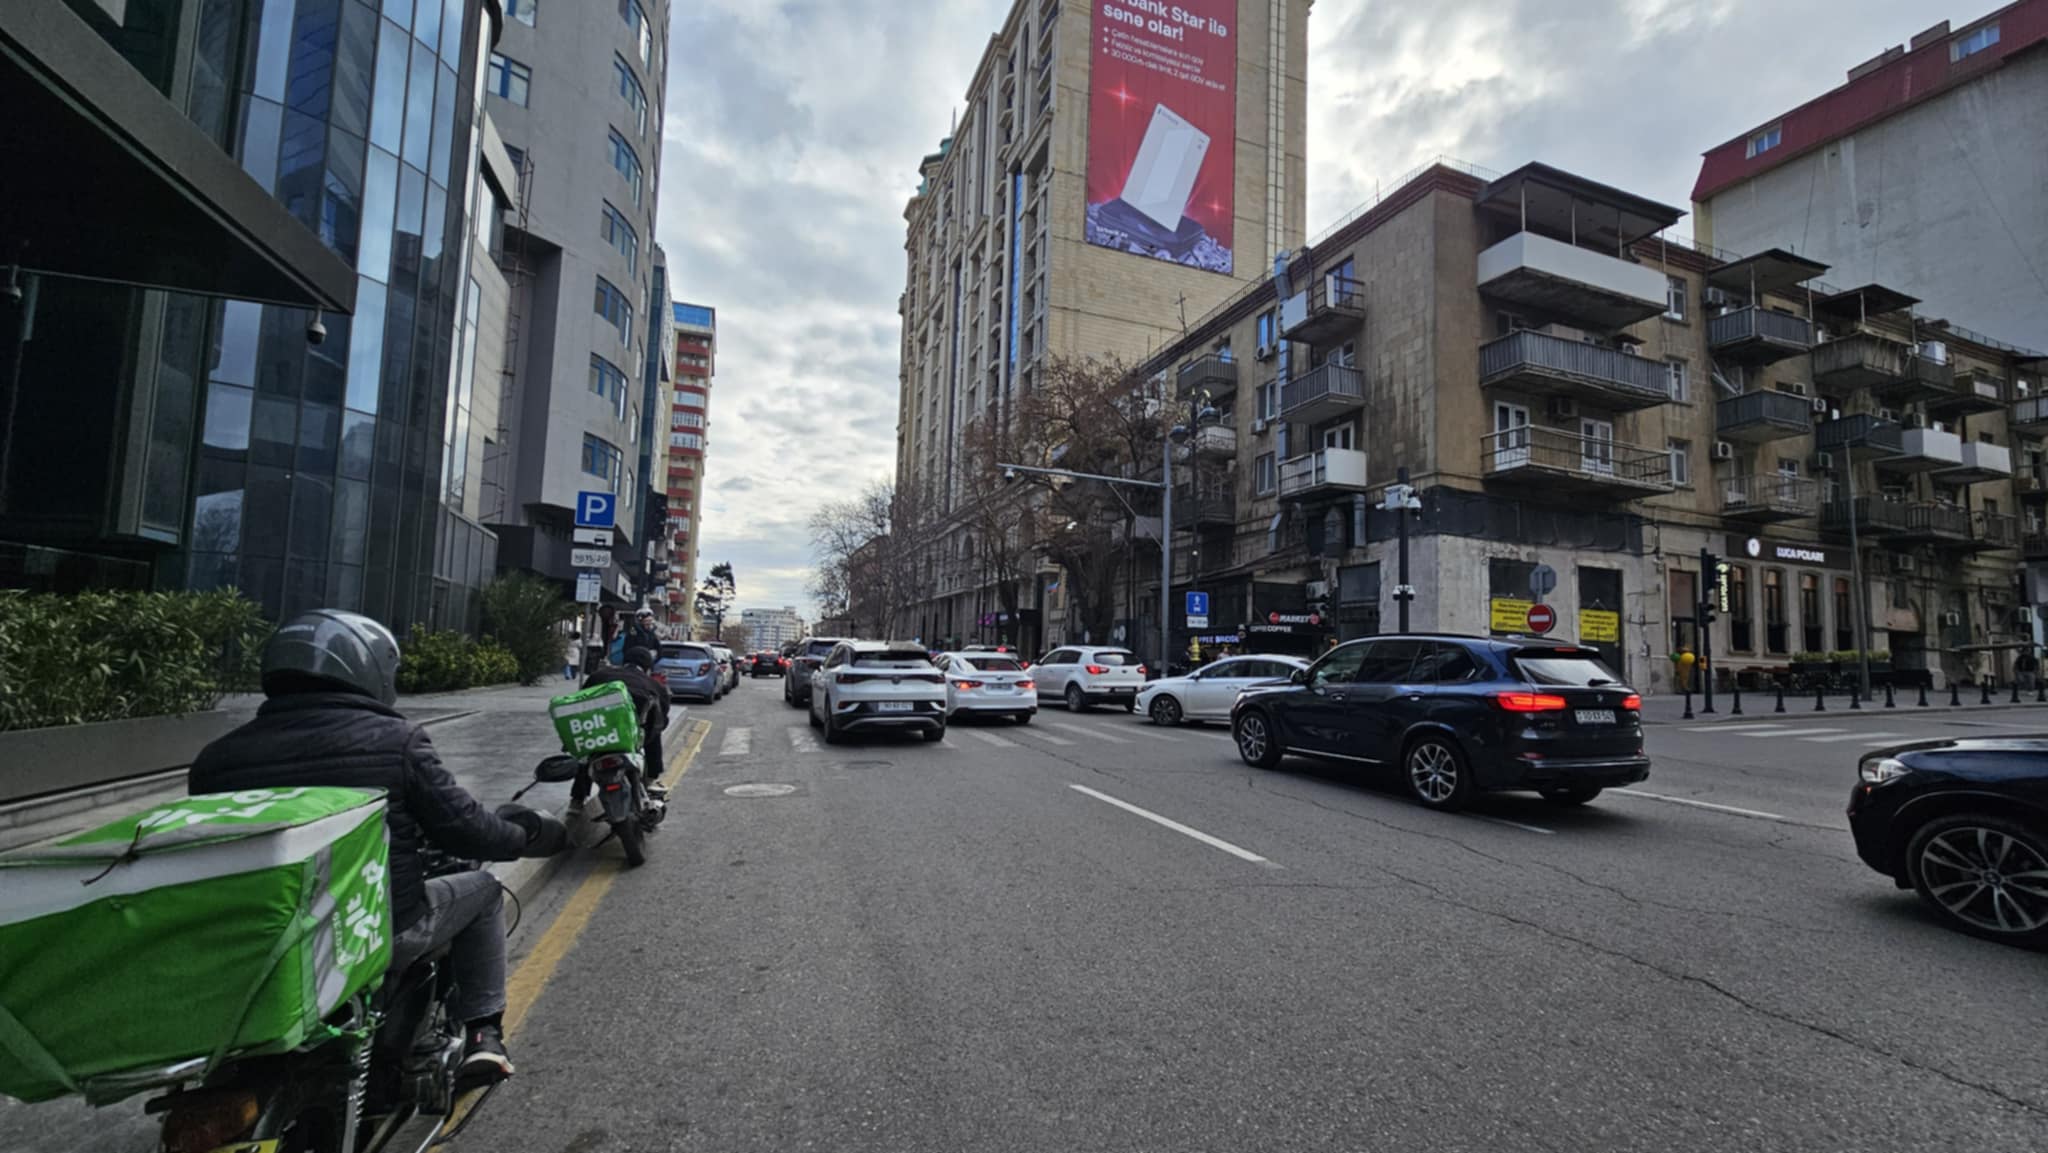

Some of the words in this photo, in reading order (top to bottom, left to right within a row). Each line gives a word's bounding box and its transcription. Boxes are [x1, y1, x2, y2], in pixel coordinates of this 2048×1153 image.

[1103, 4, 1144, 28] sənə
[1148, 19, 1184, 42] olar!
[1171, 6, 1206, 30] Star
[1208, 17, 1228, 37] ilə
[585, 495, 608, 523] P
[1776, 547, 1796, 560] LUCA
[569, 713, 607, 735] Bolt
[574, 728, 620, 752] Food
